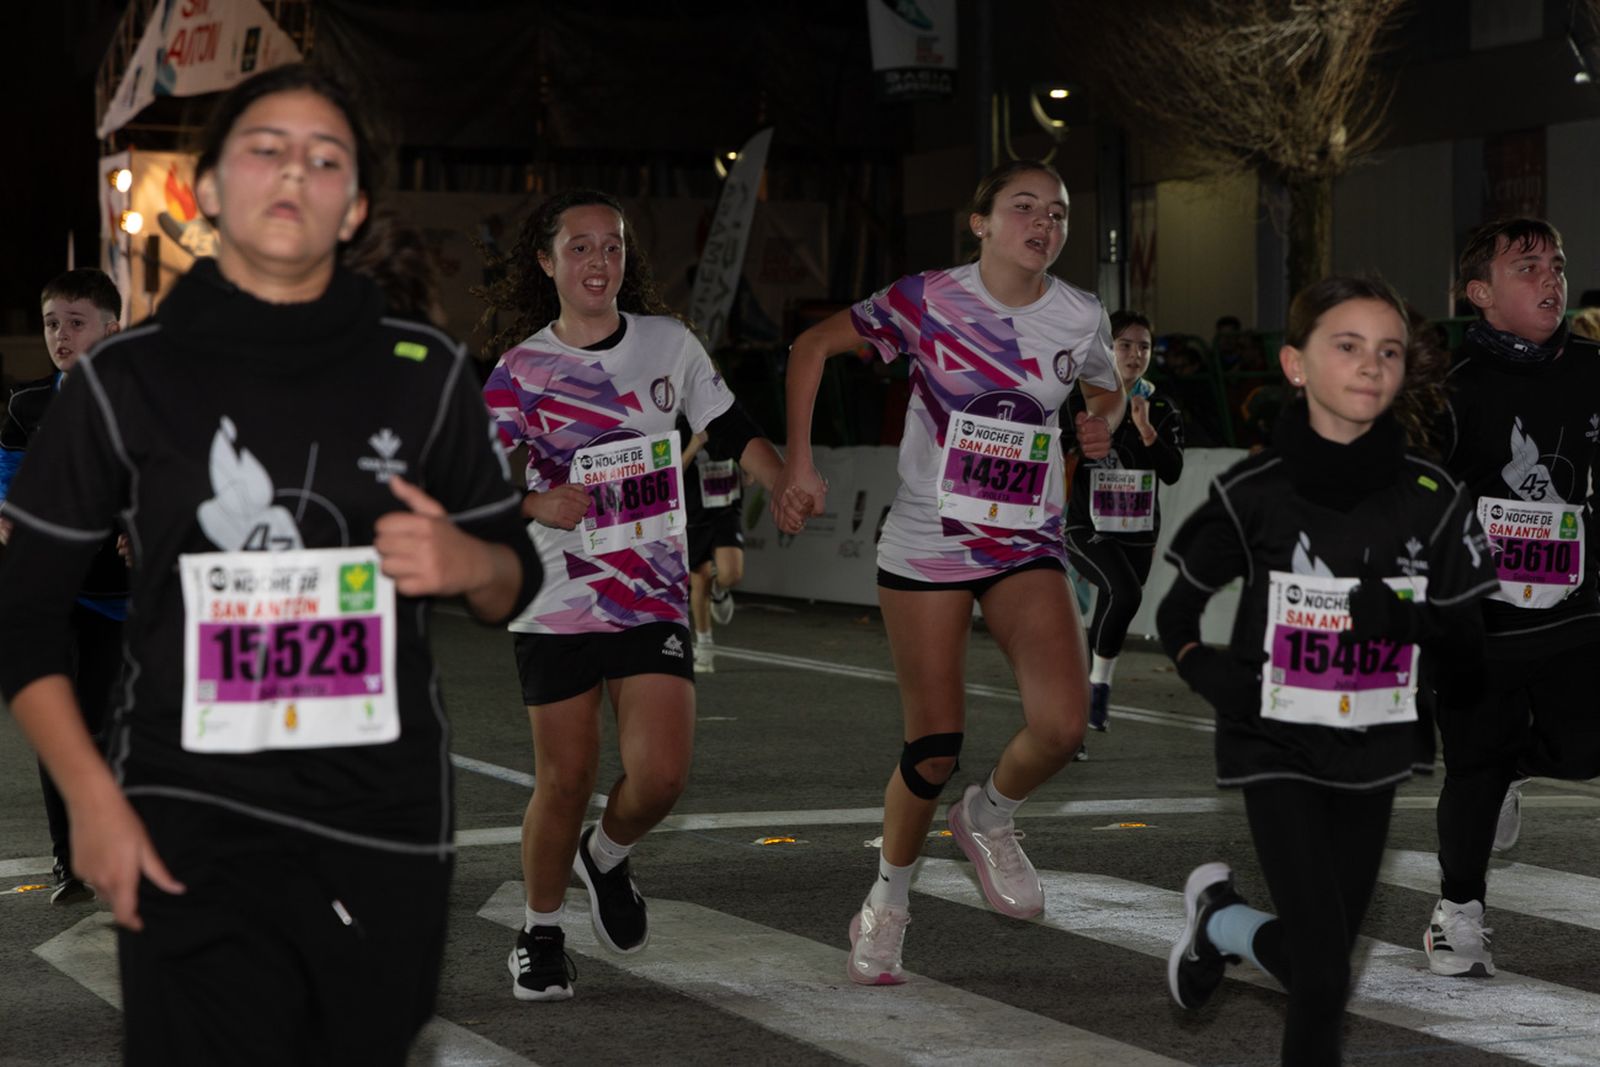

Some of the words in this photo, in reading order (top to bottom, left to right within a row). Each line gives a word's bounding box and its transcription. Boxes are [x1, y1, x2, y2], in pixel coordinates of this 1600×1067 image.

[975, 428, 1011, 444] NOCHE
[1011, 435, 1024, 446] DE
[595, 453, 629, 468] NOCHE
[631, 450, 643, 463] DE
[959, 438, 982, 453] SAN
[984, 444, 1022, 460] ANTÓN
[584, 472, 607, 485] SAN
[610, 462, 646, 479] ANTÓN
[961, 453, 1040, 494] 14321
[1519, 473, 1548, 501] 43
[1504, 512, 1538, 525] NOCHE
[1540, 515, 1553, 526] DE
[1489, 523, 1512, 535] SAN
[1514, 524, 1551, 539] ANTÓN
[211, 600, 248, 619] SAN
[1286, 610, 1316, 626] SAN
[213, 621, 368, 681] 15523
[1286, 631, 1400, 676] 15462
